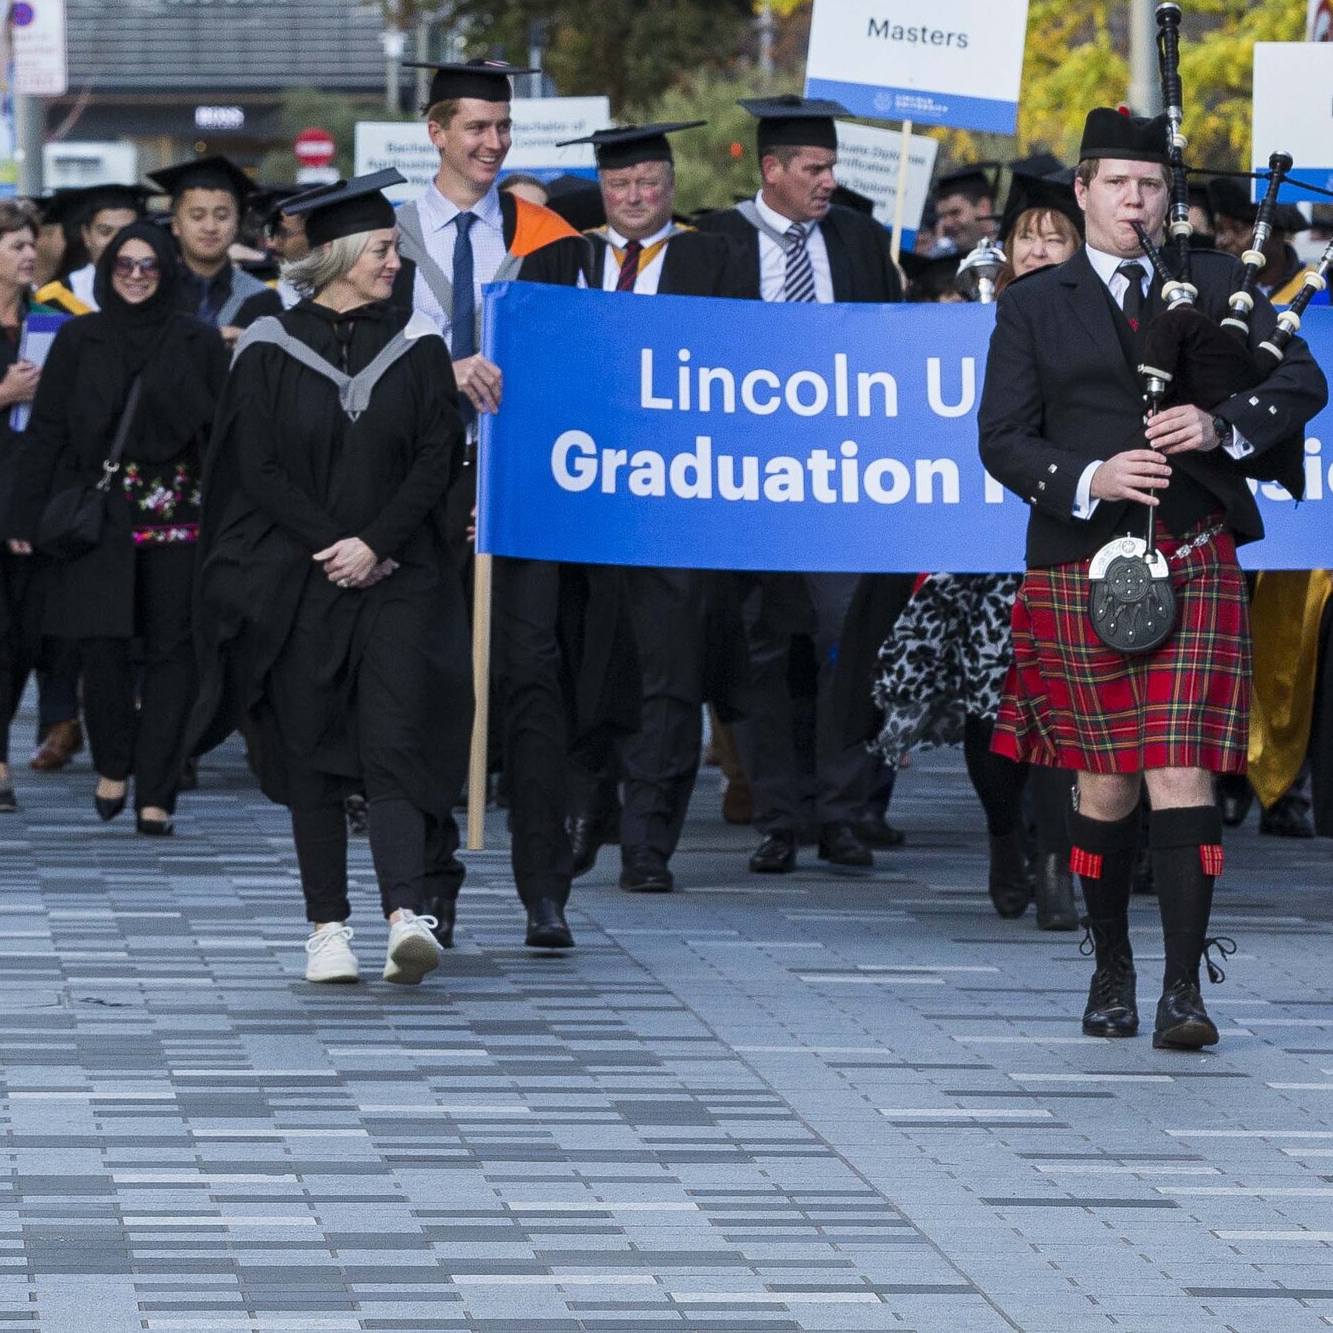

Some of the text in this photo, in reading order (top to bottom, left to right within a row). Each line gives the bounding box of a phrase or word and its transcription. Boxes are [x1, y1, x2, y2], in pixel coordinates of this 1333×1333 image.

[867, 17, 969, 49] Masters
[641, 348, 898, 417] Lincoln
[551, 429, 960, 505] Graduation
